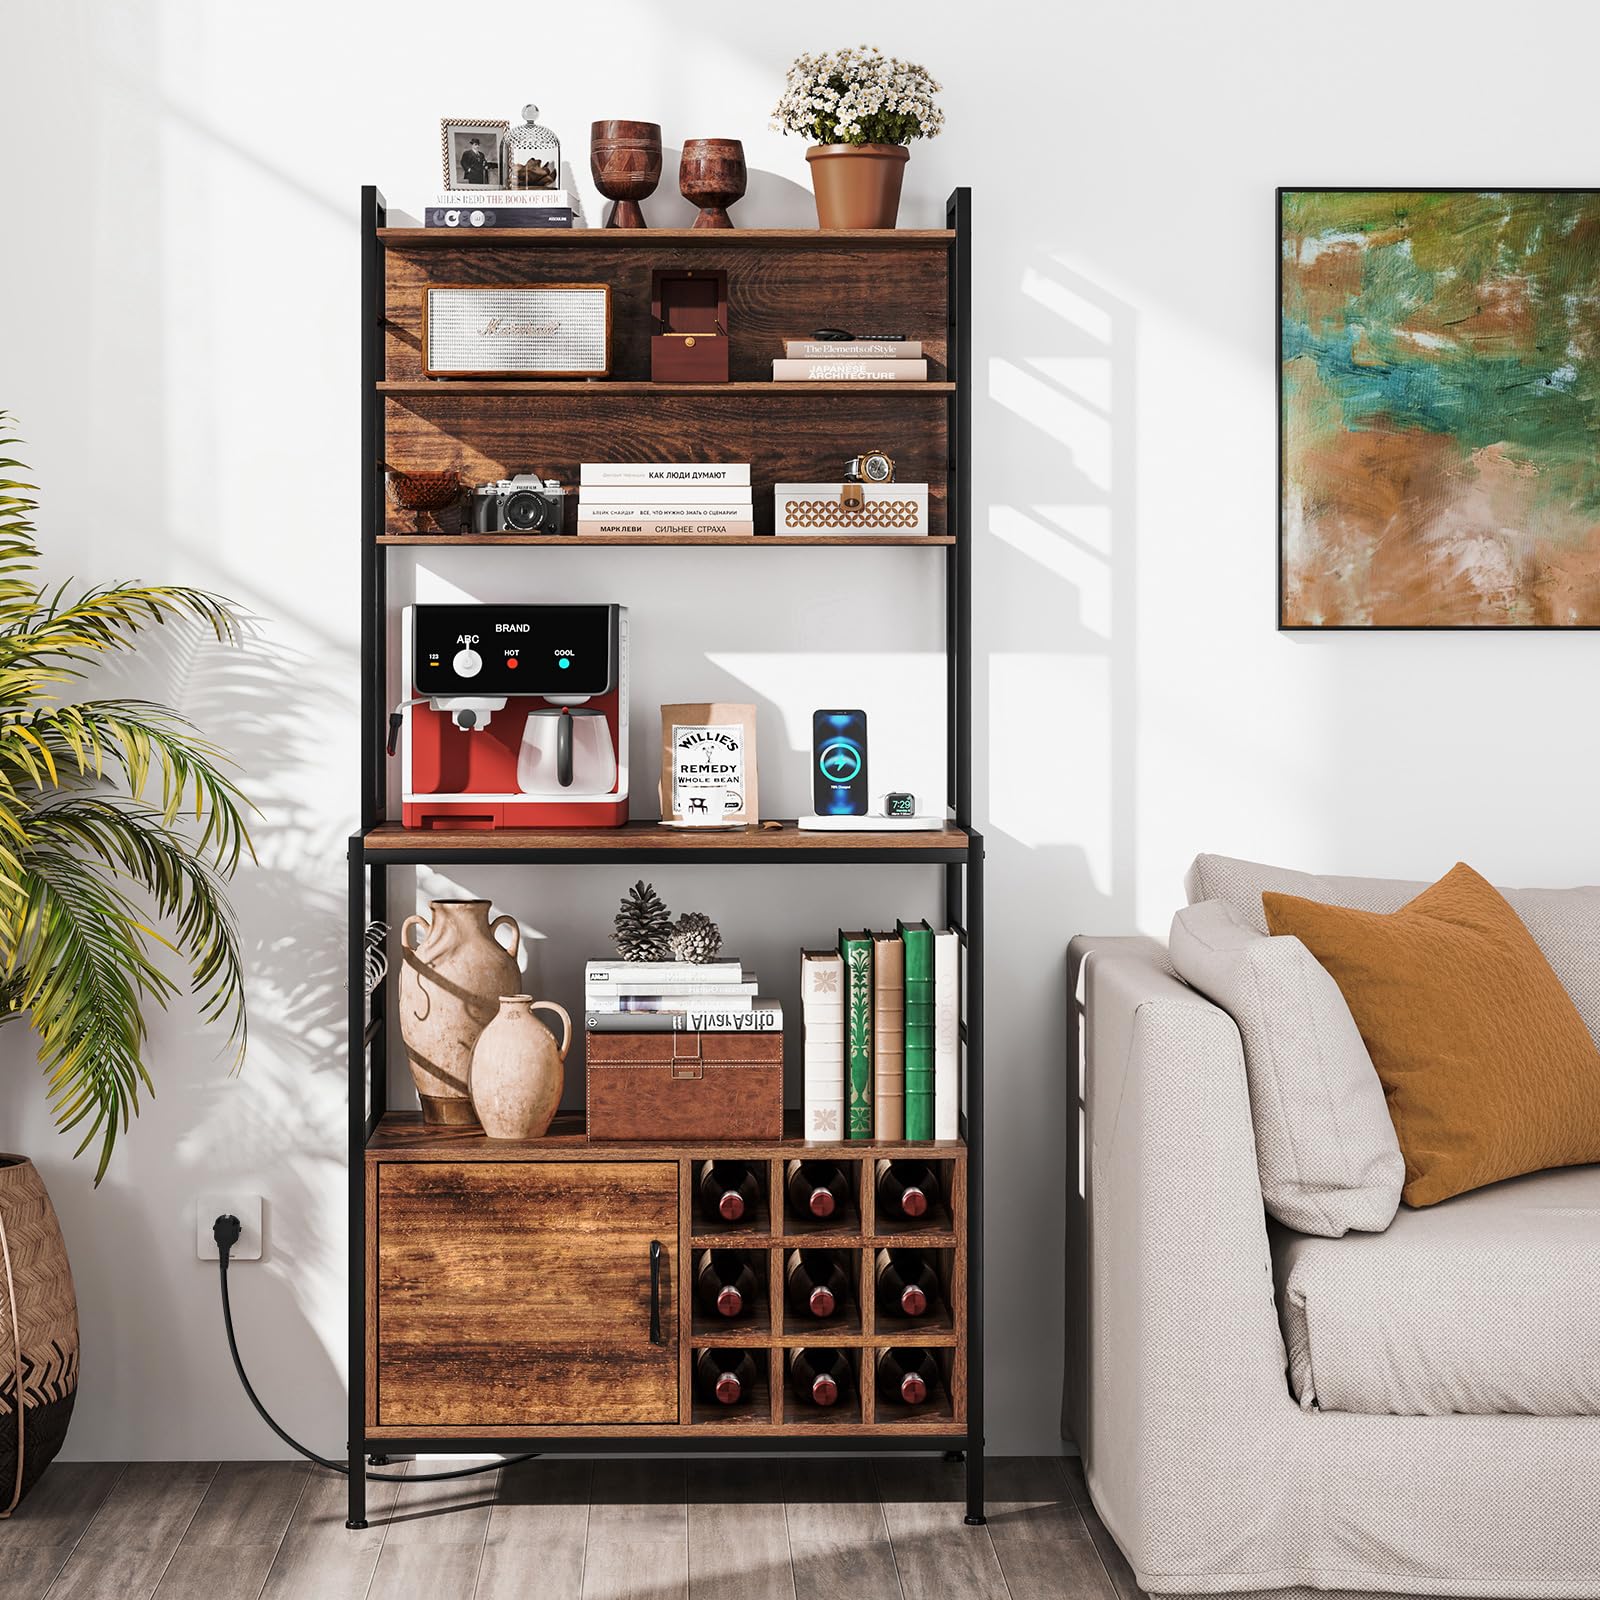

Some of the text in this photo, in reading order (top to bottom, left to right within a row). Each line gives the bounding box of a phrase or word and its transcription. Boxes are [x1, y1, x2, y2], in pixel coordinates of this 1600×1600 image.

[487, 195, 502, 204] THE
[505, 195, 527, 204] BOOK
[529, 195, 540, 204] OF
[804, 345, 897, 354] The Elements of Style
[808, 372, 896, 380] ARCHITECTURE
[666, 472, 691, 480] ЛЮДИ
[692, 472, 727, 480] ДУМАЮТ
[495, 624, 530, 632] BRAND
[456, 635, 480, 644] ABC
[678, 732, 739, 751] WILLIE'S
[680, 765, 737, 773] REMEDY
[892, 800, 911, 809] 7:29
